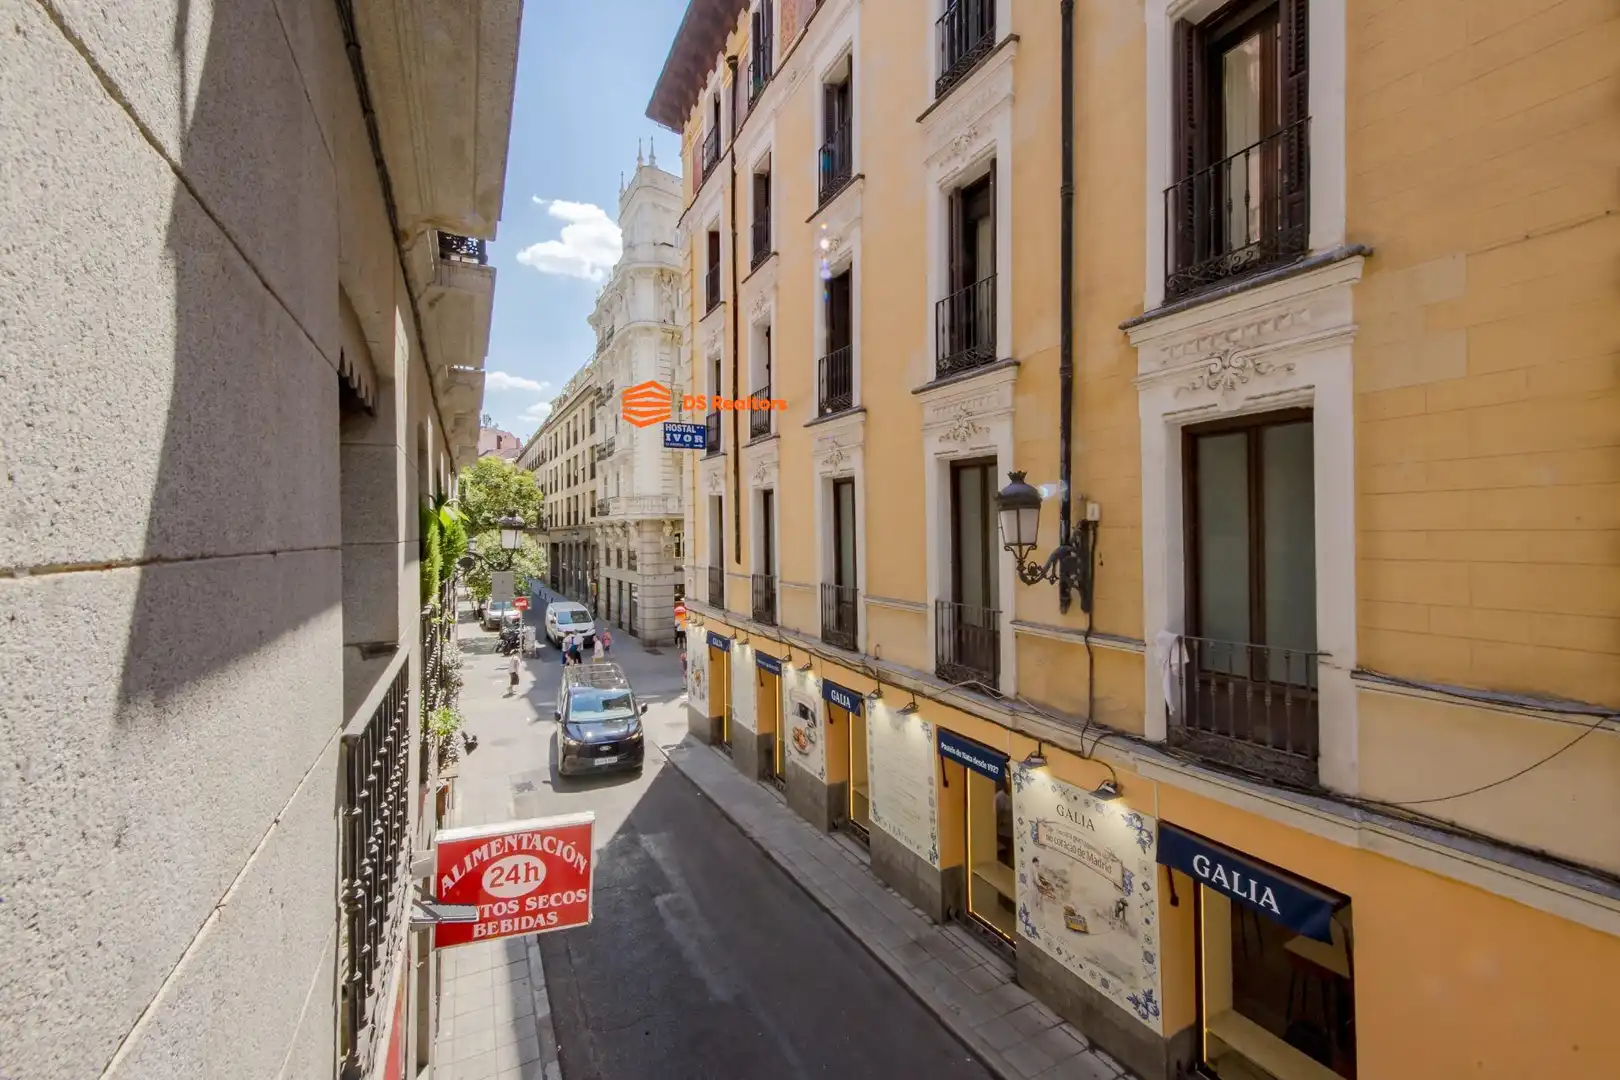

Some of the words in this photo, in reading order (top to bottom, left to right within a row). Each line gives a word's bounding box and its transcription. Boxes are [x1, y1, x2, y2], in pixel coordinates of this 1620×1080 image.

[665, 423, 697, 434] HOSTAL
[665, 433, 704, 444] IVOR
[830, 689, 851, 709] GALIA
[1056, 804, 1096, 832] GALIA
[440, 832, 588, 897] ALIMENTACIÓN
[489, 861, 540, 889] 24h
[1086, 850, 1113, 875] Madrid
[1192, 854, 1281, 916] GALIA
[525, 888, 588, 912] SECOS
[473, 911, 559, 940] BEBIDAS
